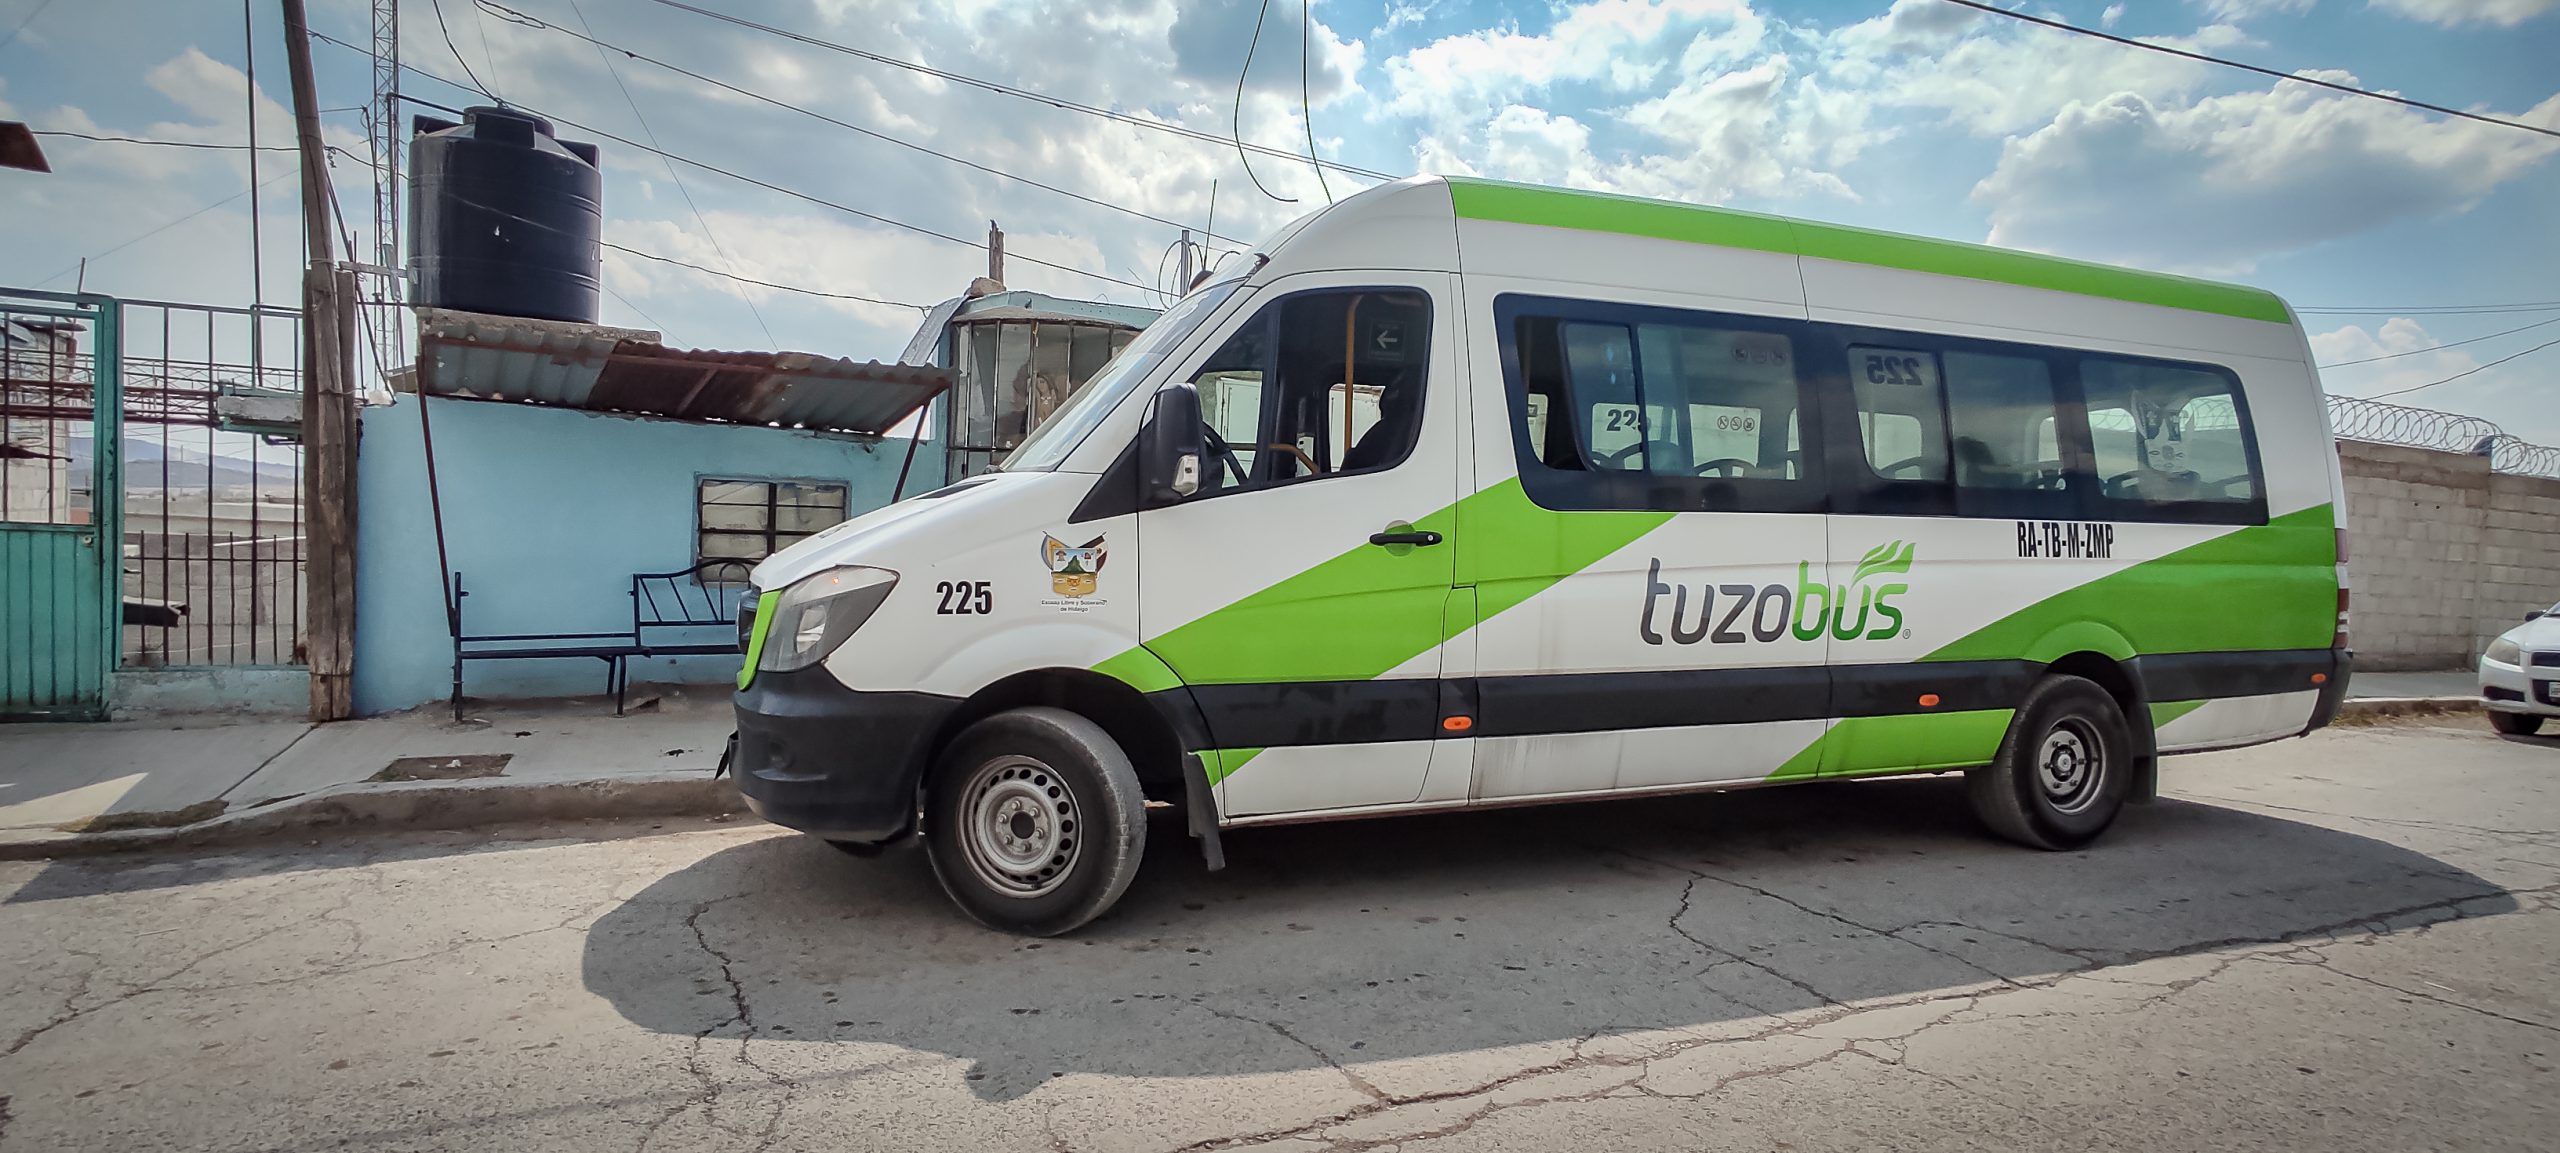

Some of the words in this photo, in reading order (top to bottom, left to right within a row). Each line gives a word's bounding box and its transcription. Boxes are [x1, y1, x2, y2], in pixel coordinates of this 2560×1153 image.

[2017, 521, 2114, 558] RA-TB-M-ZMP
[936, 581, 993, 615] 225
[1640, 557, 1909, 646] tuzobus
